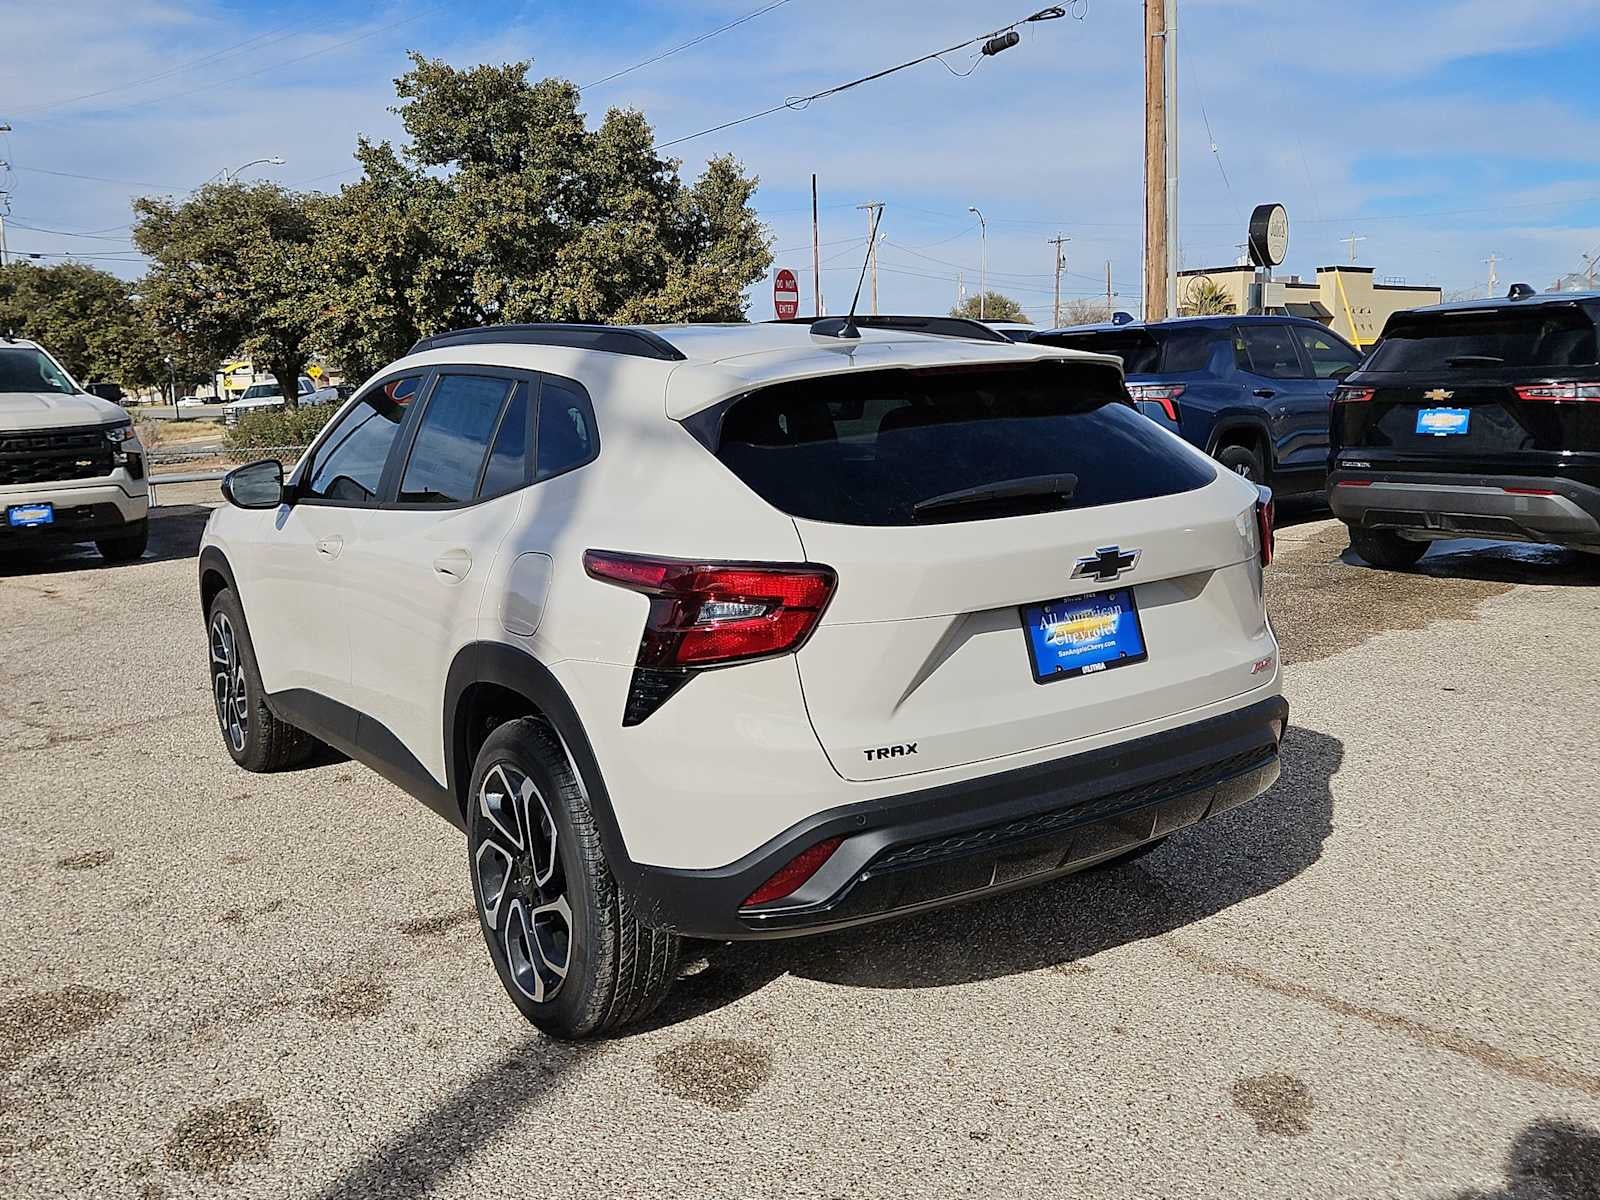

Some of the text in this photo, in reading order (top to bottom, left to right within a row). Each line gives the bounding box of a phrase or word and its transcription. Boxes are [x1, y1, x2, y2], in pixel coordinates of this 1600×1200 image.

[776, 279, 795, 289] DO NOT
[779, 304, 795, 314] ENTER
[1039, 604, 1122, 630] All American
[1055, 621, 1117, 645] Chevrolet
[1058, 640, 1116, 658] SanAngeloChevy.com
[863, 742, 919, 761] TRAX
